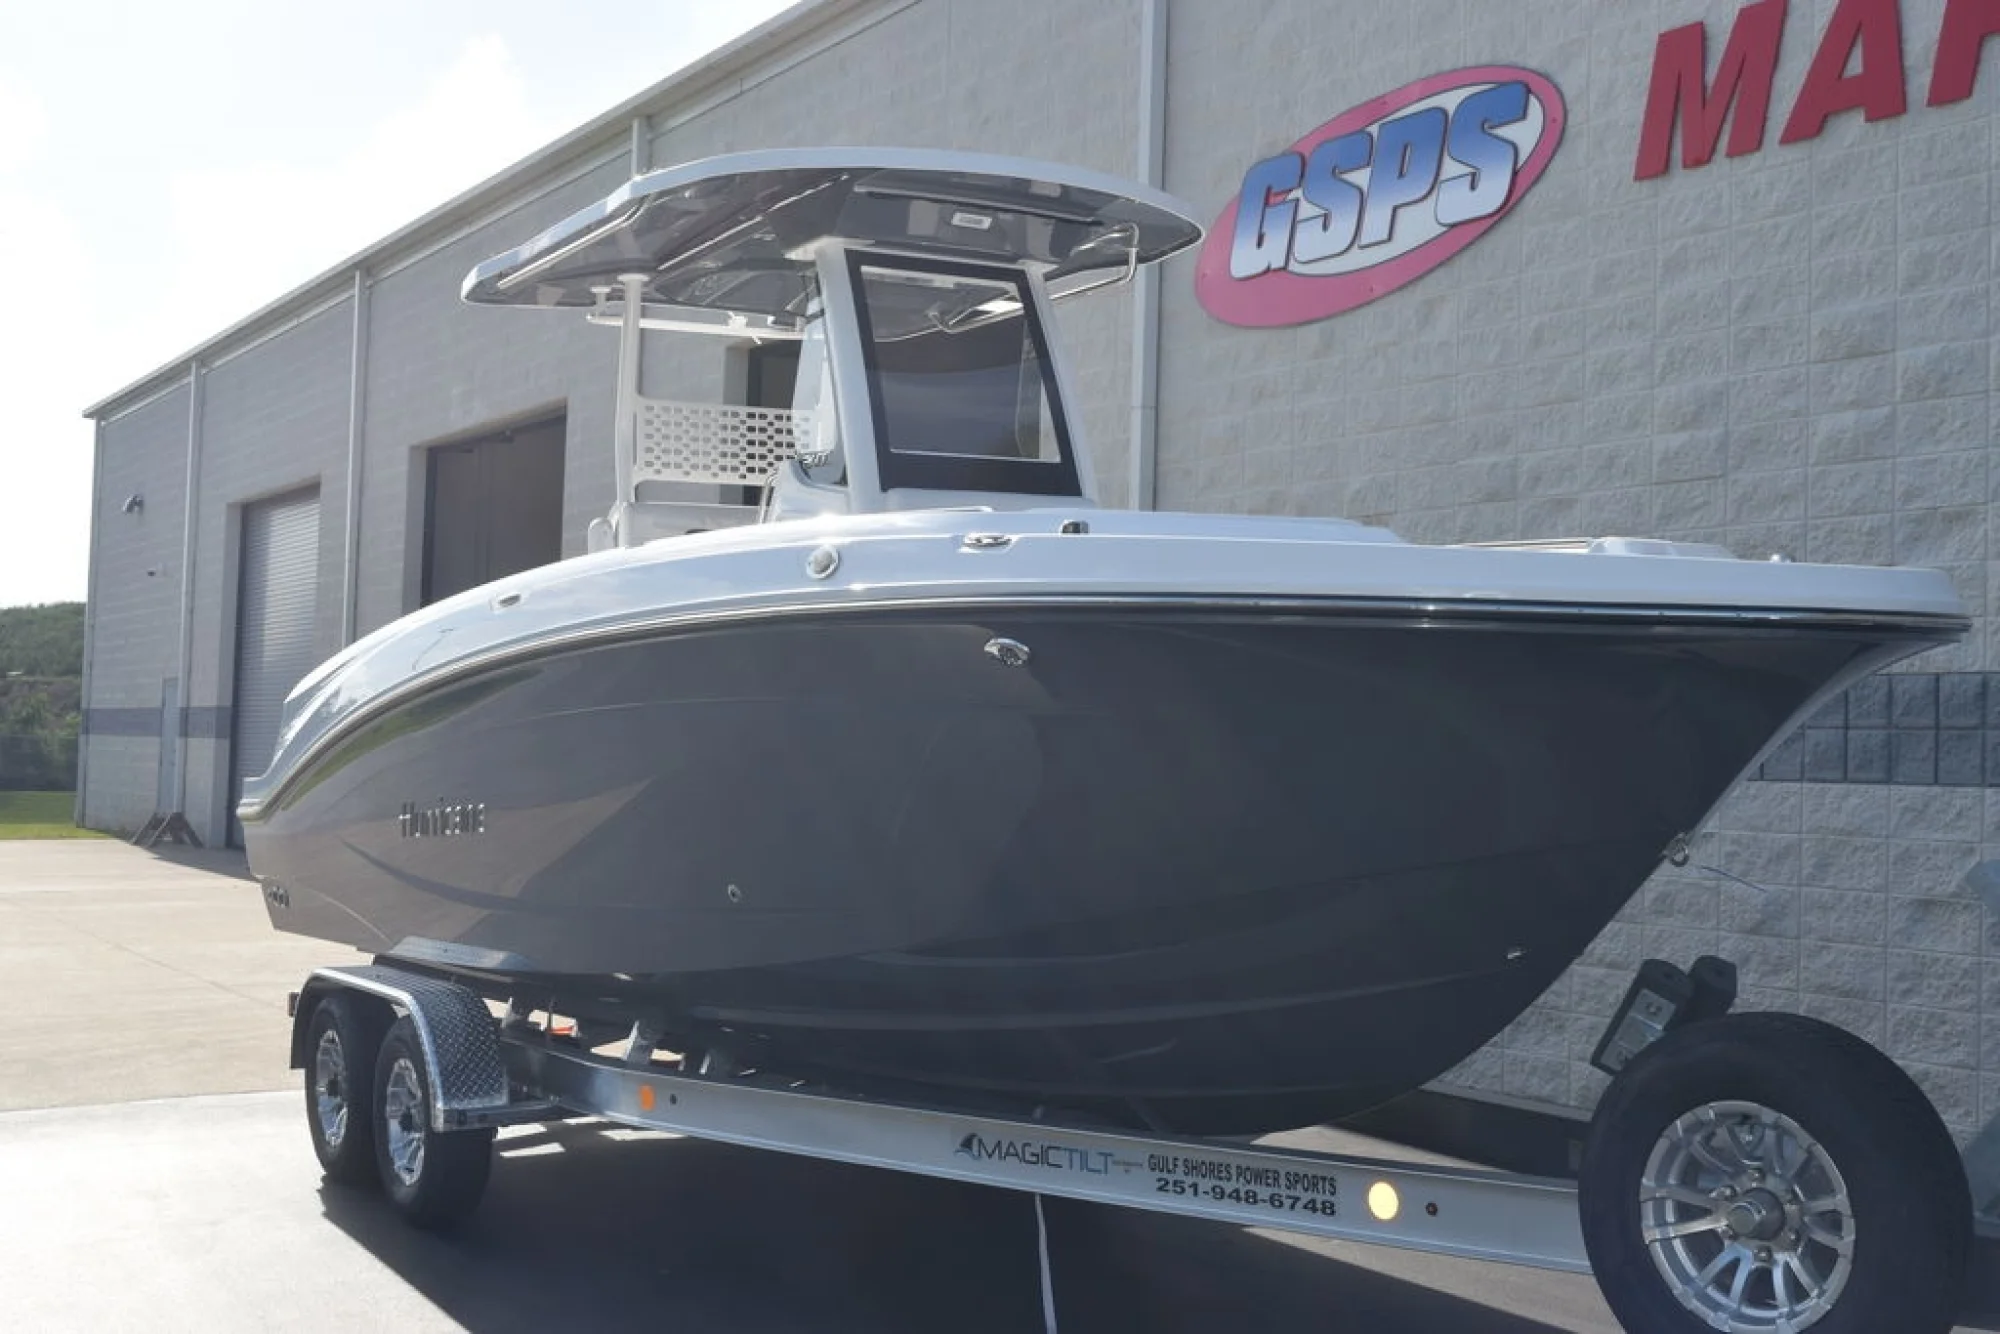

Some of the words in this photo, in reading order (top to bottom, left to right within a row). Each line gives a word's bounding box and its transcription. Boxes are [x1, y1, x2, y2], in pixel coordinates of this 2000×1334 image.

[1229, 81, 1532, 280] GSPS
[977, 1137, 1114, 1176] MAGICTILT
[1148, 1154, 1179, 1175] GULF
[1183, 1158, 1233, 1182] SHORES
[1236, 1165, 1281, 1188] POWER
[1284, 1171, 1337, 1196] SPORTS
[1156, 1177, 1336, 1216] 251-948-6748
